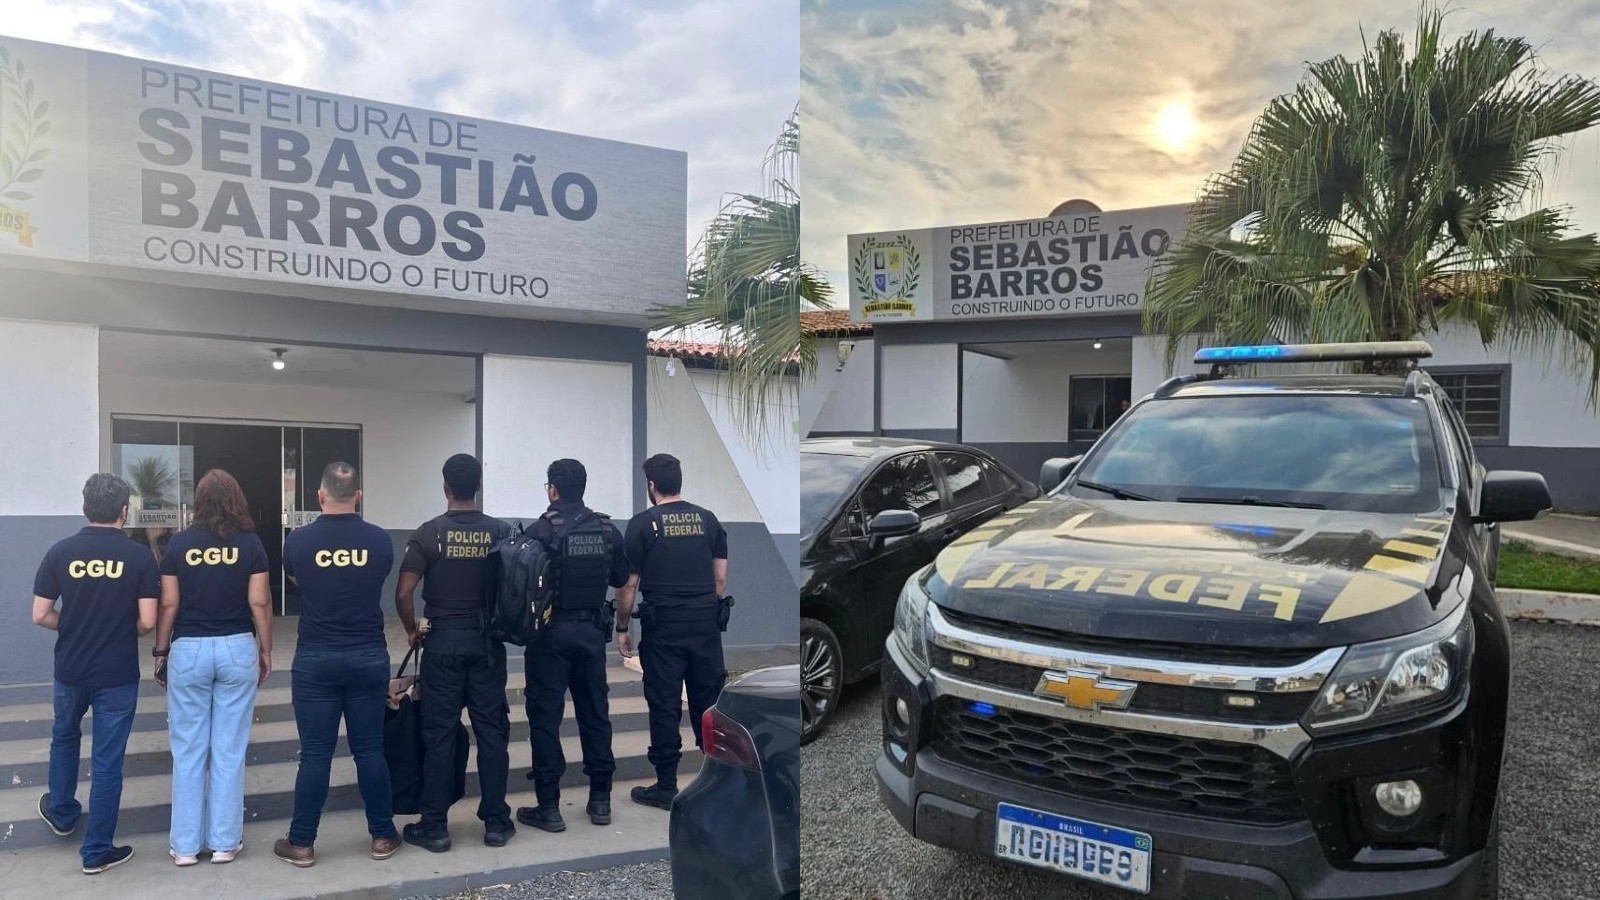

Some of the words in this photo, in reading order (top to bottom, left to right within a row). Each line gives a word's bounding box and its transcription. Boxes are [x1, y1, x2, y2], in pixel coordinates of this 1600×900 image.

[141, 67, 417, 143] PREFEITURA
[428, 117, 477, 152] DE
[137, 107, 598, 221] SEBASTIÃO
[141, 168, 486, 261] BARROS
[951, 219, 1068, 244] PREFEITURA
[1073, 216, 1100, 233] DE
[949, 225, 1170, 272] SEBASTIÃO
[144, 237, 391, 284] CONSTRUINDO
[402, 265, 423, 287] O
[434, 267, 549, 298] FUTURO
[951, 264, 1103, 299] BARROS
[952, 299, 1055, 315] CONSTRUINDO
[1059, 298, 1070, 310] O
[1075, 293, 1139, 309] FUTURO
[664, 525, 704, 536] FEDERAL
[185, 547, 239, 566] CGU
[315, 549, 368, 567] CGU
[568, 545, 605, 555] FEDERAL
[69, 560, 124, 578] CGU
[1059, 822, 1083, 834] BRASIL
